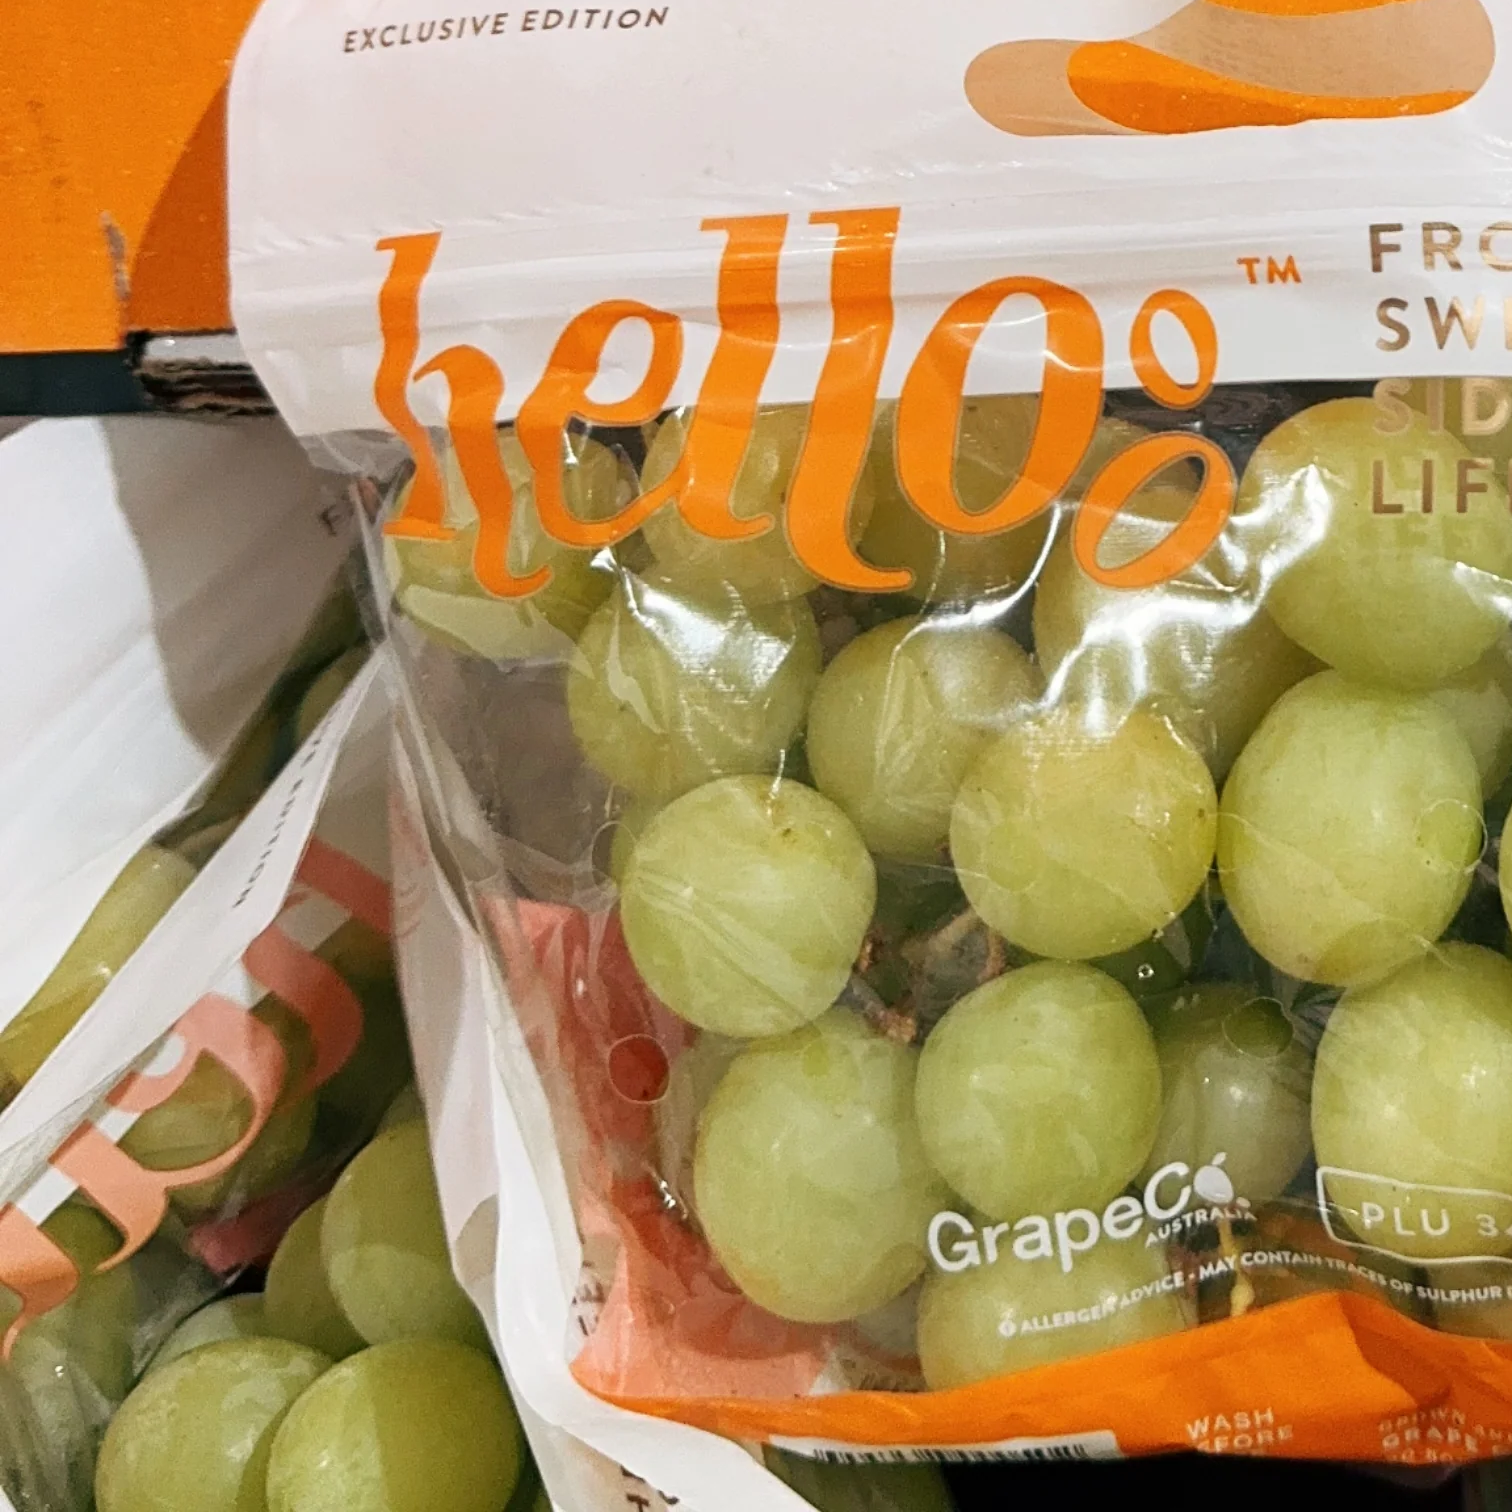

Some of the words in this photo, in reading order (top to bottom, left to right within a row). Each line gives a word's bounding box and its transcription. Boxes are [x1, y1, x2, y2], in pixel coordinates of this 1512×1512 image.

[343, 11, 509, 53] EXCLUSIVE
[521, 6, 670, 33] EDITION
[1236, 254, 1302, 285] TM
[1144, 1205, 1258, 1248] AUSTRALIA
[1360, 1199, 1451, 1236] PLU
[1119, 1274, 1186, 1309] ADVICE
[1199, 1254, 1236, 1281] MAY
[1240, 1250, 1323, 1268] CONTAIN
[1325, 1257, 1388, 1288] TRACES
[1389, 1279, 1414, 1297] OF
[1416, 1285, 1503, 1304] SULPHUR
[1185, 1406, 1275, 1442] WASH
